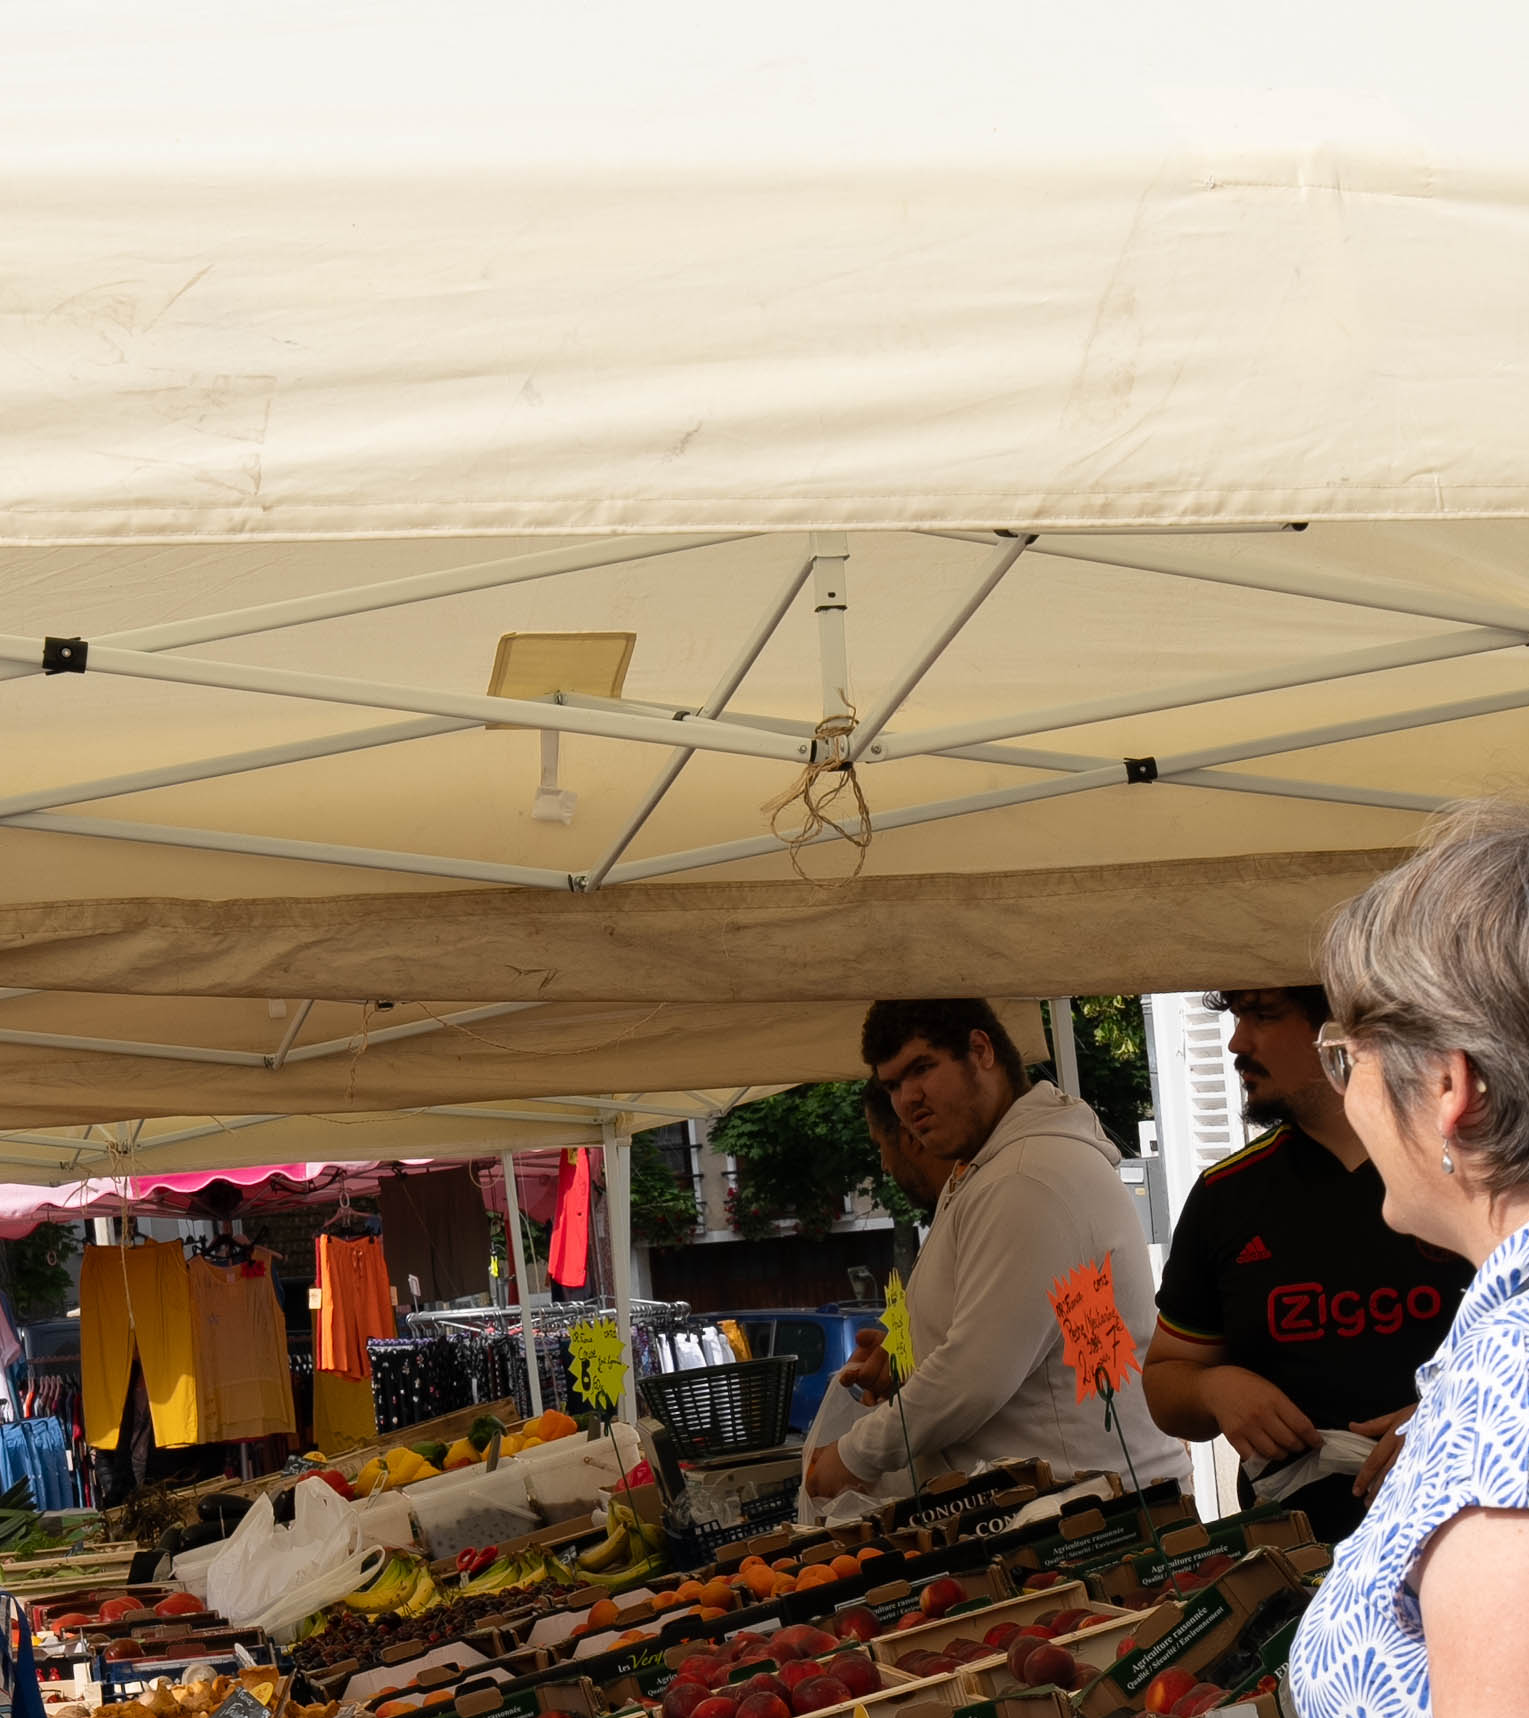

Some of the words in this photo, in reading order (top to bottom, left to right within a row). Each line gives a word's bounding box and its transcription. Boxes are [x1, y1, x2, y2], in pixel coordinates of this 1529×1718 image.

[1126, 1666, 1151, 1691] Qualité
[1151, 1646, 1176, 1671] Sécurité
[1180, 1606, 1225, 1646] Environnement
[1131, 1635, 1173, 1674] Agriculture
[1172, 1605, 1209, 1645] raisonnée
